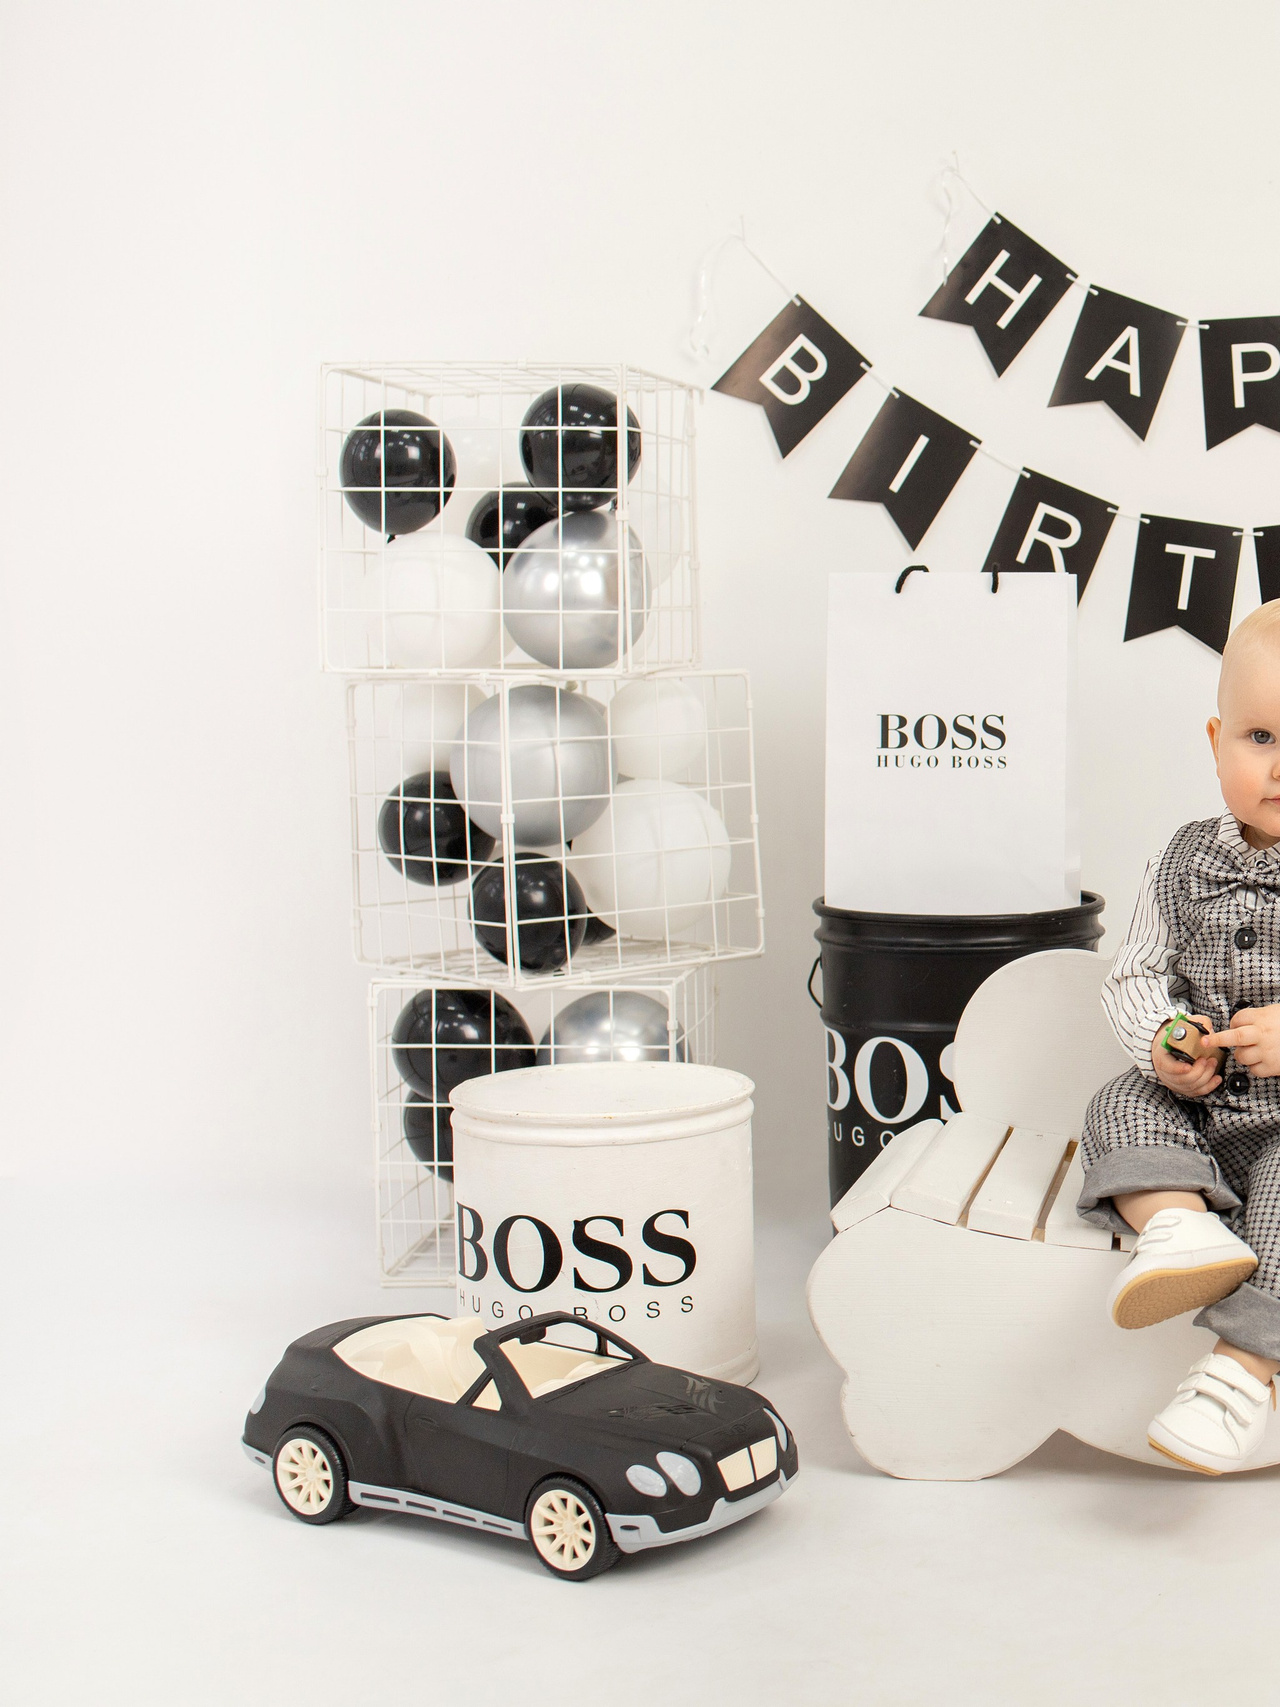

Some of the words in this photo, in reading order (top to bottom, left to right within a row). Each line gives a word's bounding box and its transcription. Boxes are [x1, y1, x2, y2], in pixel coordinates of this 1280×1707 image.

[876, 714, 1007, 751] BOSS
[876, 754, 940, 769] HUGO
[951, 754, 1008, 770] BOSS
[825, 1027, 963, 1125] BO
[833, 1120, 897, 1149] UGO
[456, 1201, 697, 1294] BOSS
[458, 1288, 535, 1321] HUGO
[572, 1295, 695, 1323] BOSS
